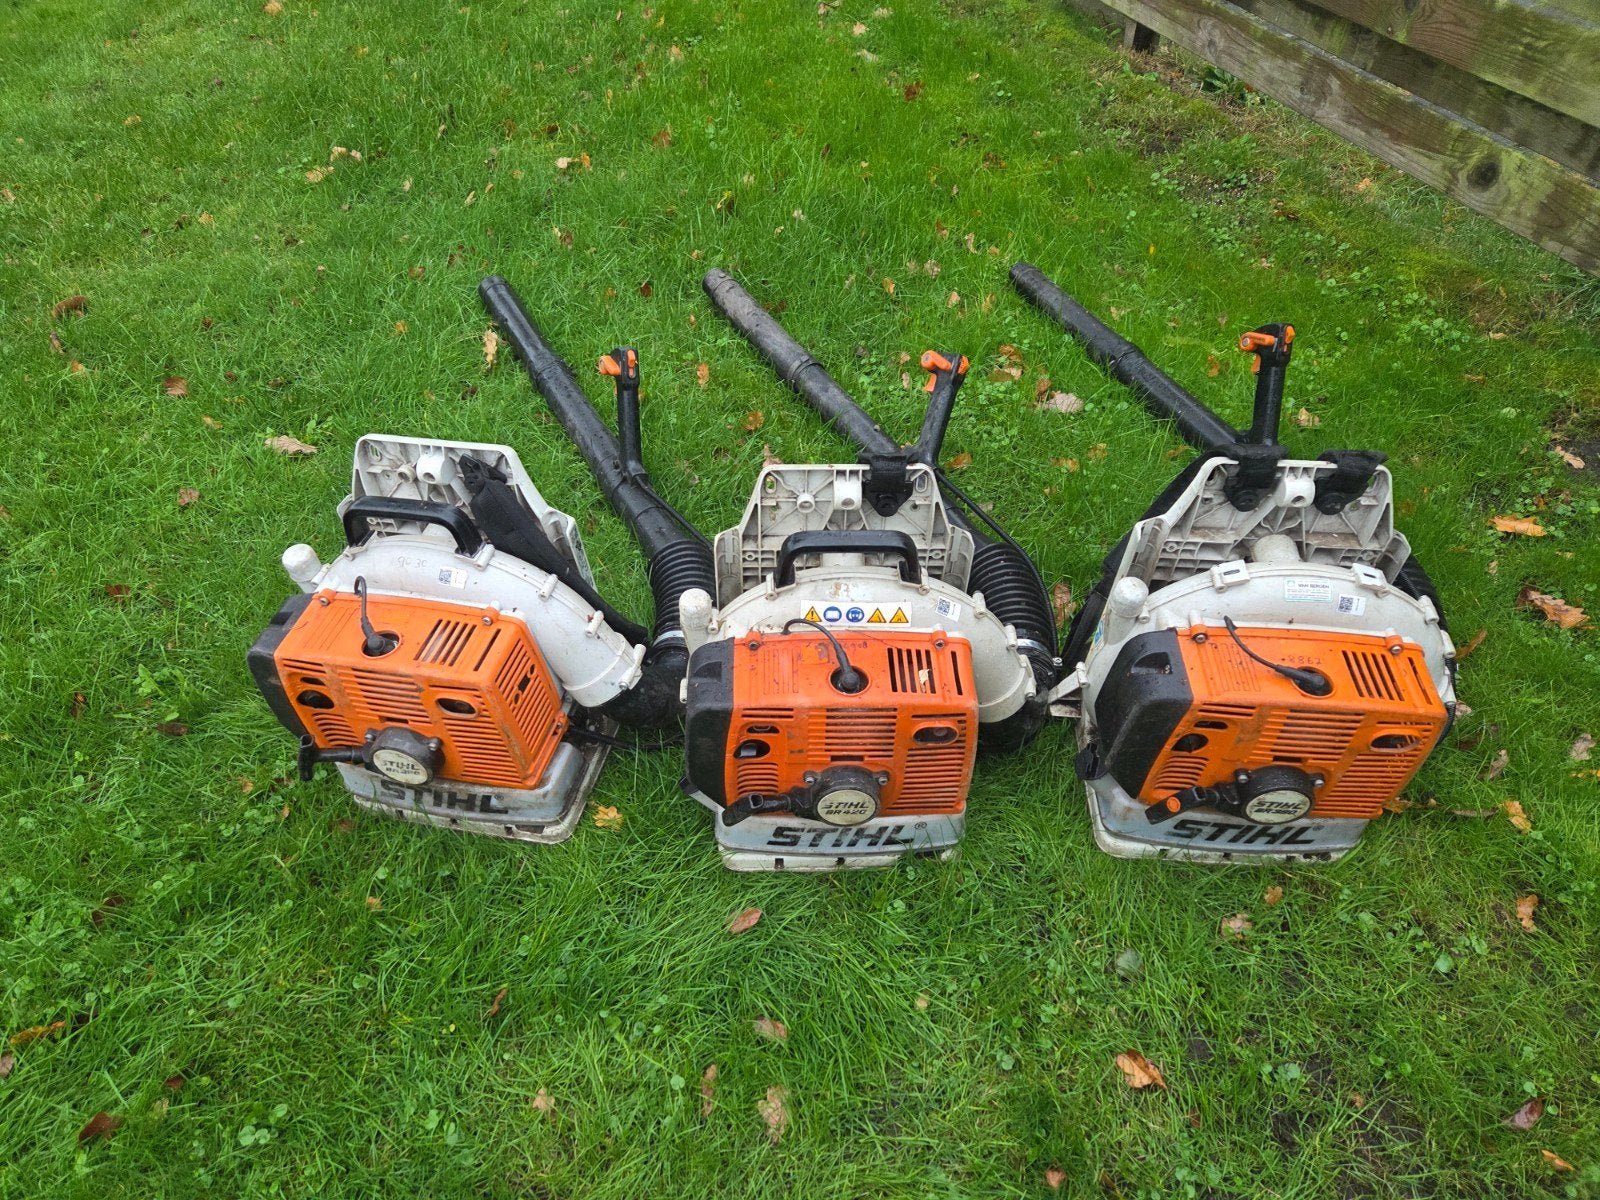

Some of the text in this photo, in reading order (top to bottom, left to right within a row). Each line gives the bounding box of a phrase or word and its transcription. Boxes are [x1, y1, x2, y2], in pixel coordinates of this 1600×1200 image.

[382, 760, 420, 770] STIHL
[381, 780, 508, 814] STIHL
[1253, 801, 1302, 809] STIHL
[767, 825, 914, 848] STIHL
[1166, 819, 1315, 845] STIHL
